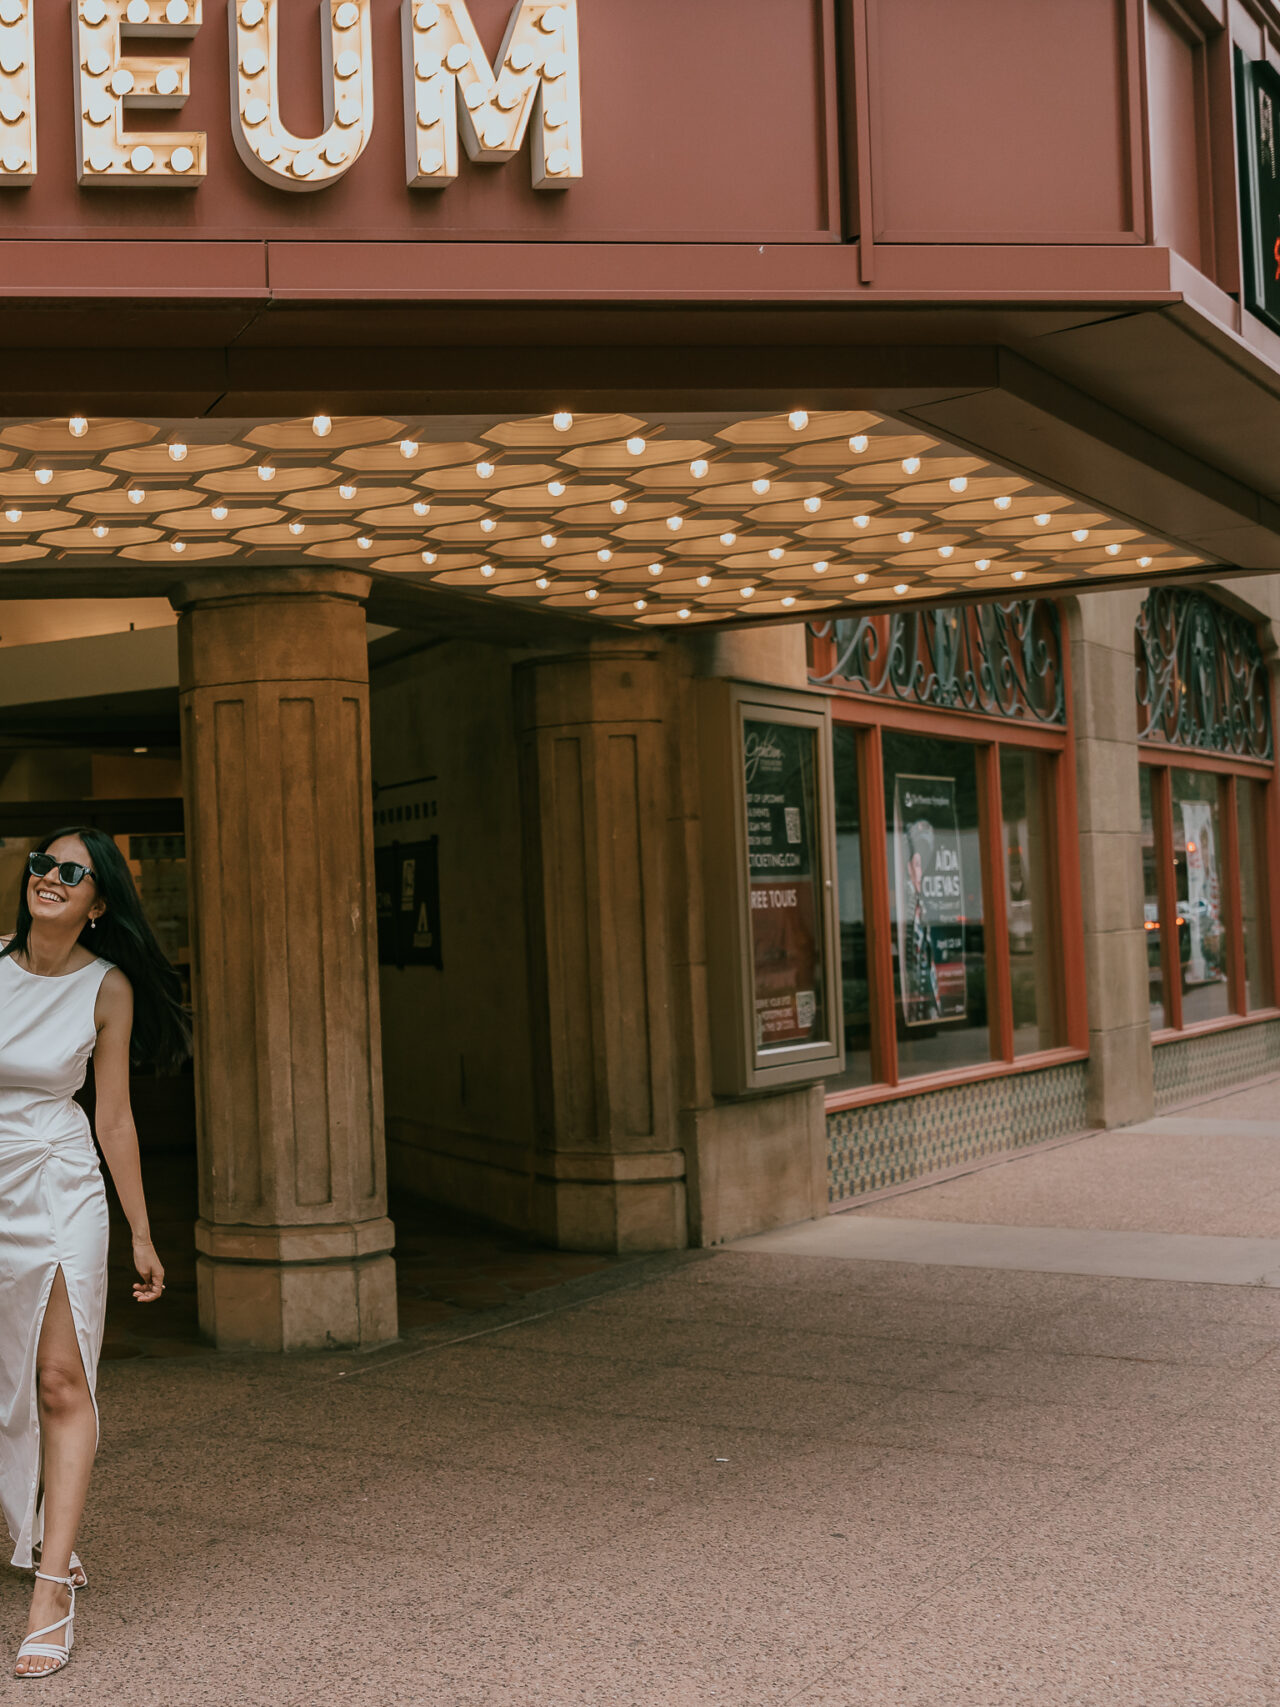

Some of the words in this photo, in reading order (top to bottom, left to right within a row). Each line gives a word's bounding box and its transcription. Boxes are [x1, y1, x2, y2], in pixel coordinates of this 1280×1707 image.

[922, 875, 960, 898] CUEVAS
[750, 890, 768, 909] REE
[769, 889, 797, 908] TOURS
